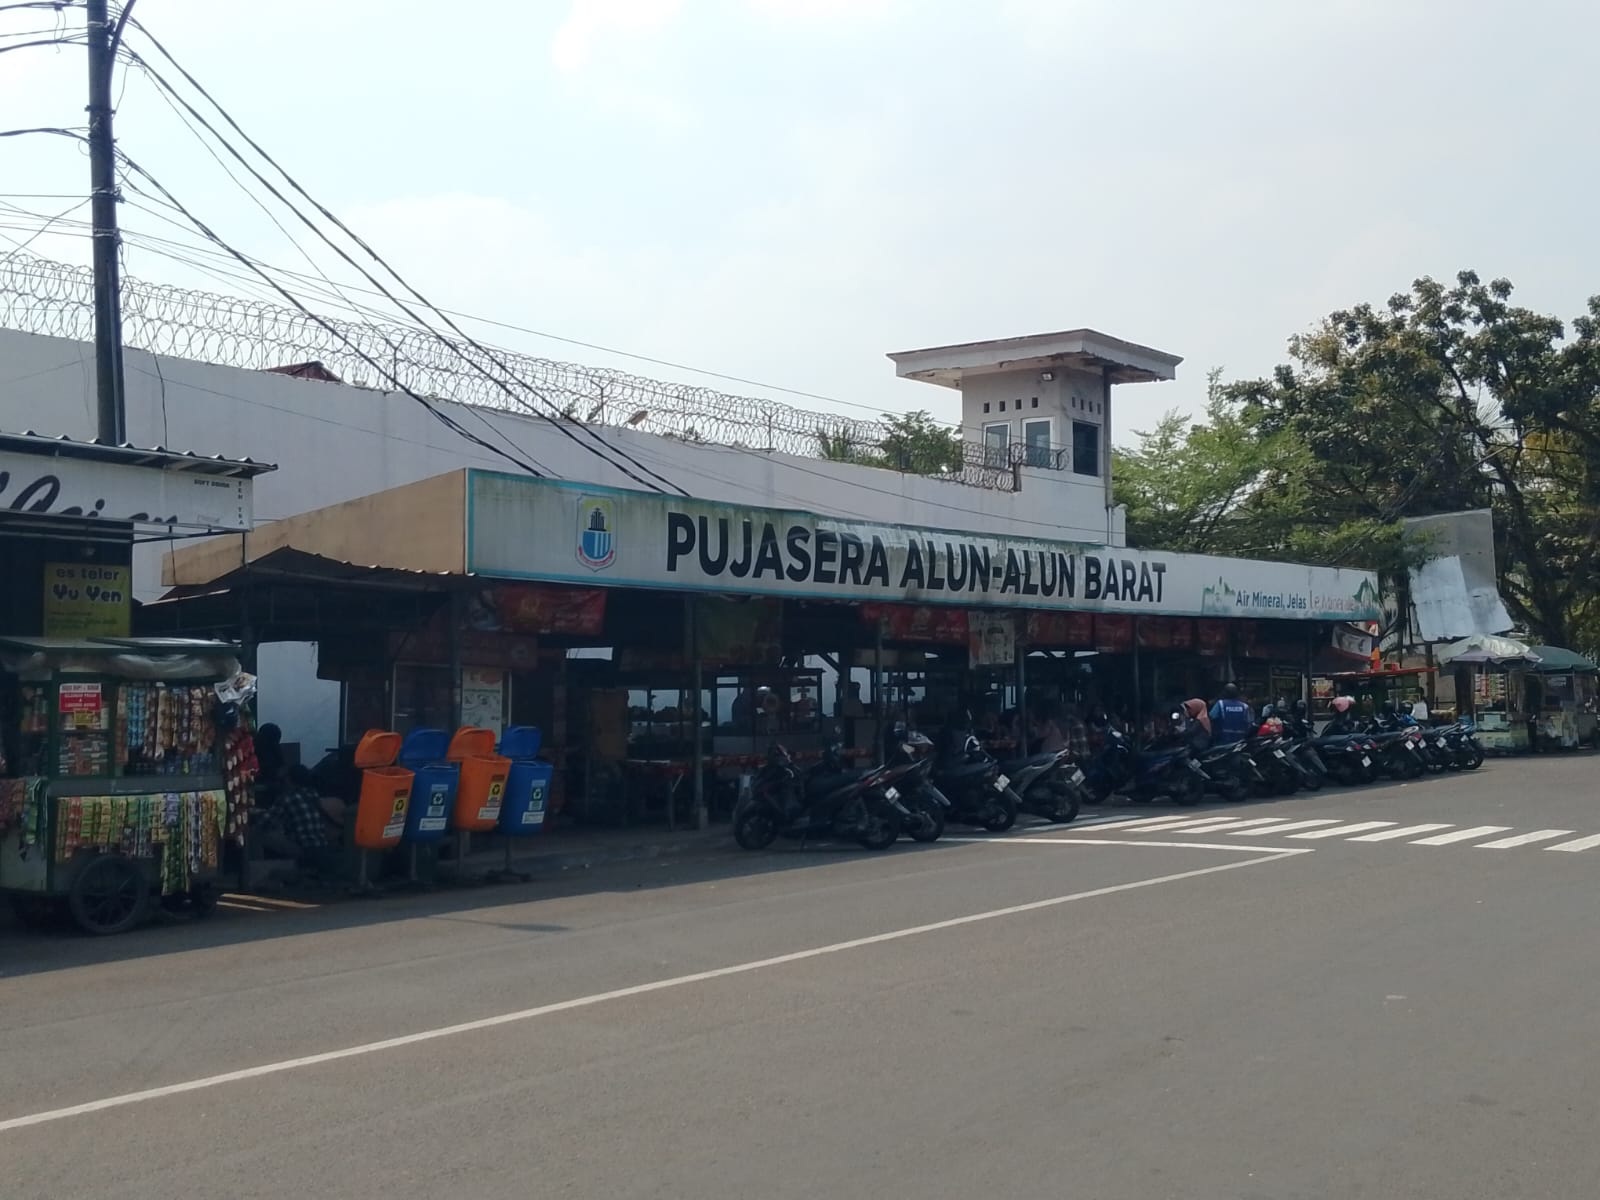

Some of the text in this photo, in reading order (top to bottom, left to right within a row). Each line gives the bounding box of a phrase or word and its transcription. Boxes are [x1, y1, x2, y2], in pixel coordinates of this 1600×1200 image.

[666, 511, 890, 587] PUJASERA
[899, 534, 1075, 599] ALUN-ALUN
[1084, 555, 1167, 602] BARAT
[56, 567, 120, 581] es teler
[1236, 589, 1307, 610] Air Mineral, Jelas
